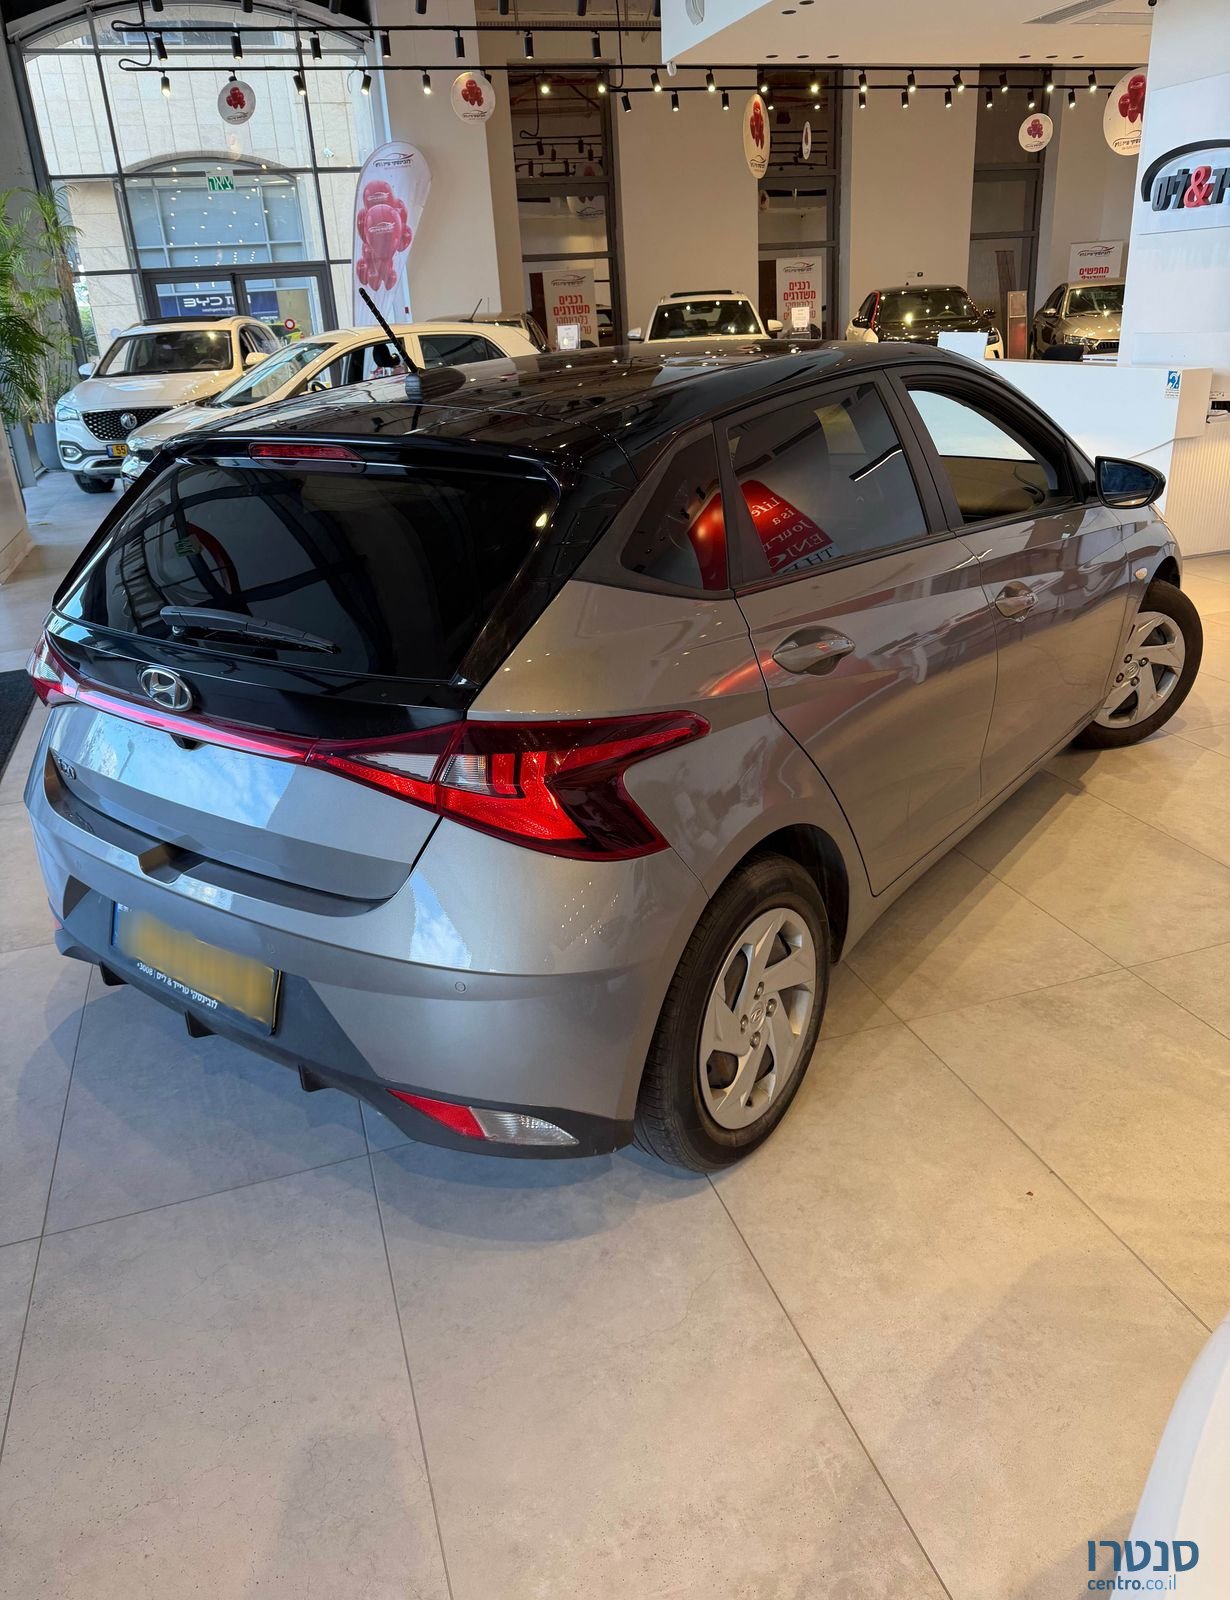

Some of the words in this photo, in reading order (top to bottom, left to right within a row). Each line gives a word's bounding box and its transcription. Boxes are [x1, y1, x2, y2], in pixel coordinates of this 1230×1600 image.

[1079, 266, 1110, 276] מחפשים
[789, 281, 811, 291] רכבים
[183, 296, 222, 308] BYD
[558, 294, 583, 305] רכבים
